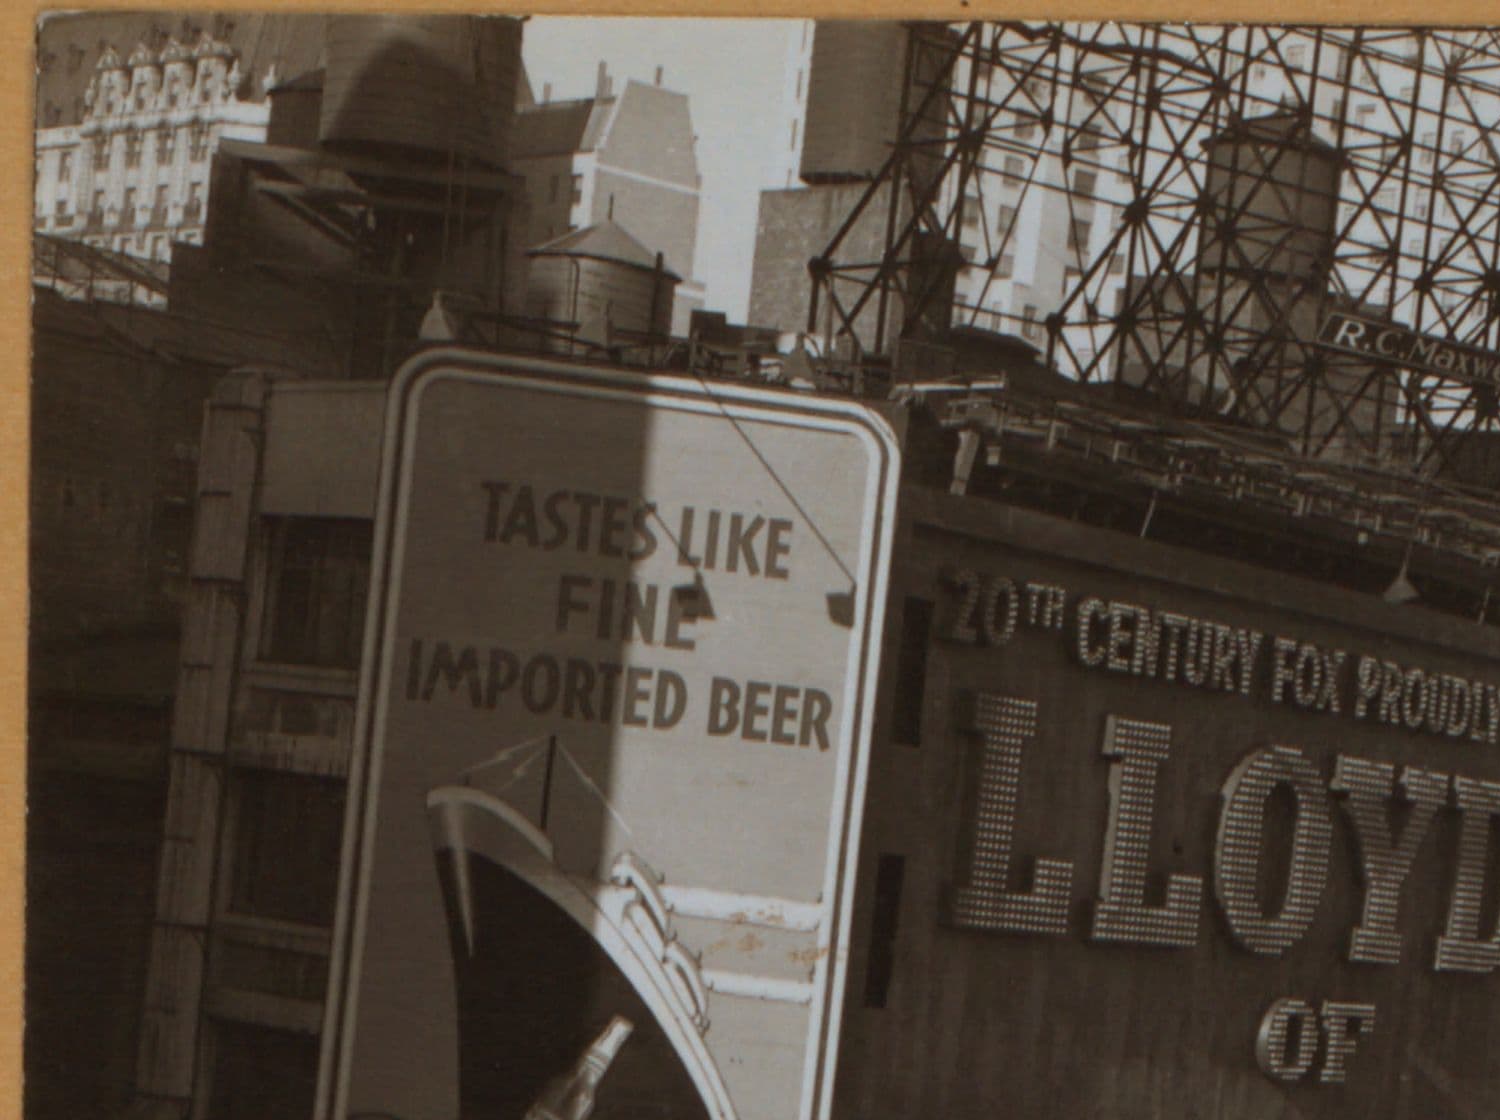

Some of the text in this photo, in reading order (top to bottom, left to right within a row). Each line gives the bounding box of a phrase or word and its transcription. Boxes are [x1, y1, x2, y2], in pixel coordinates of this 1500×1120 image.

[480, 480, 794, 580] TASTES LIKE
[555, 575, 698, 650] FINE
[940, 570, 1066, 648] 20TH
[1075, 596, 1262, 696] CENTURY
[1271, 634, 1346, 714] FOX
[405, 638, 834, 752] IMPORTED BEER
[1255, 998, 1377, 1083] OF
